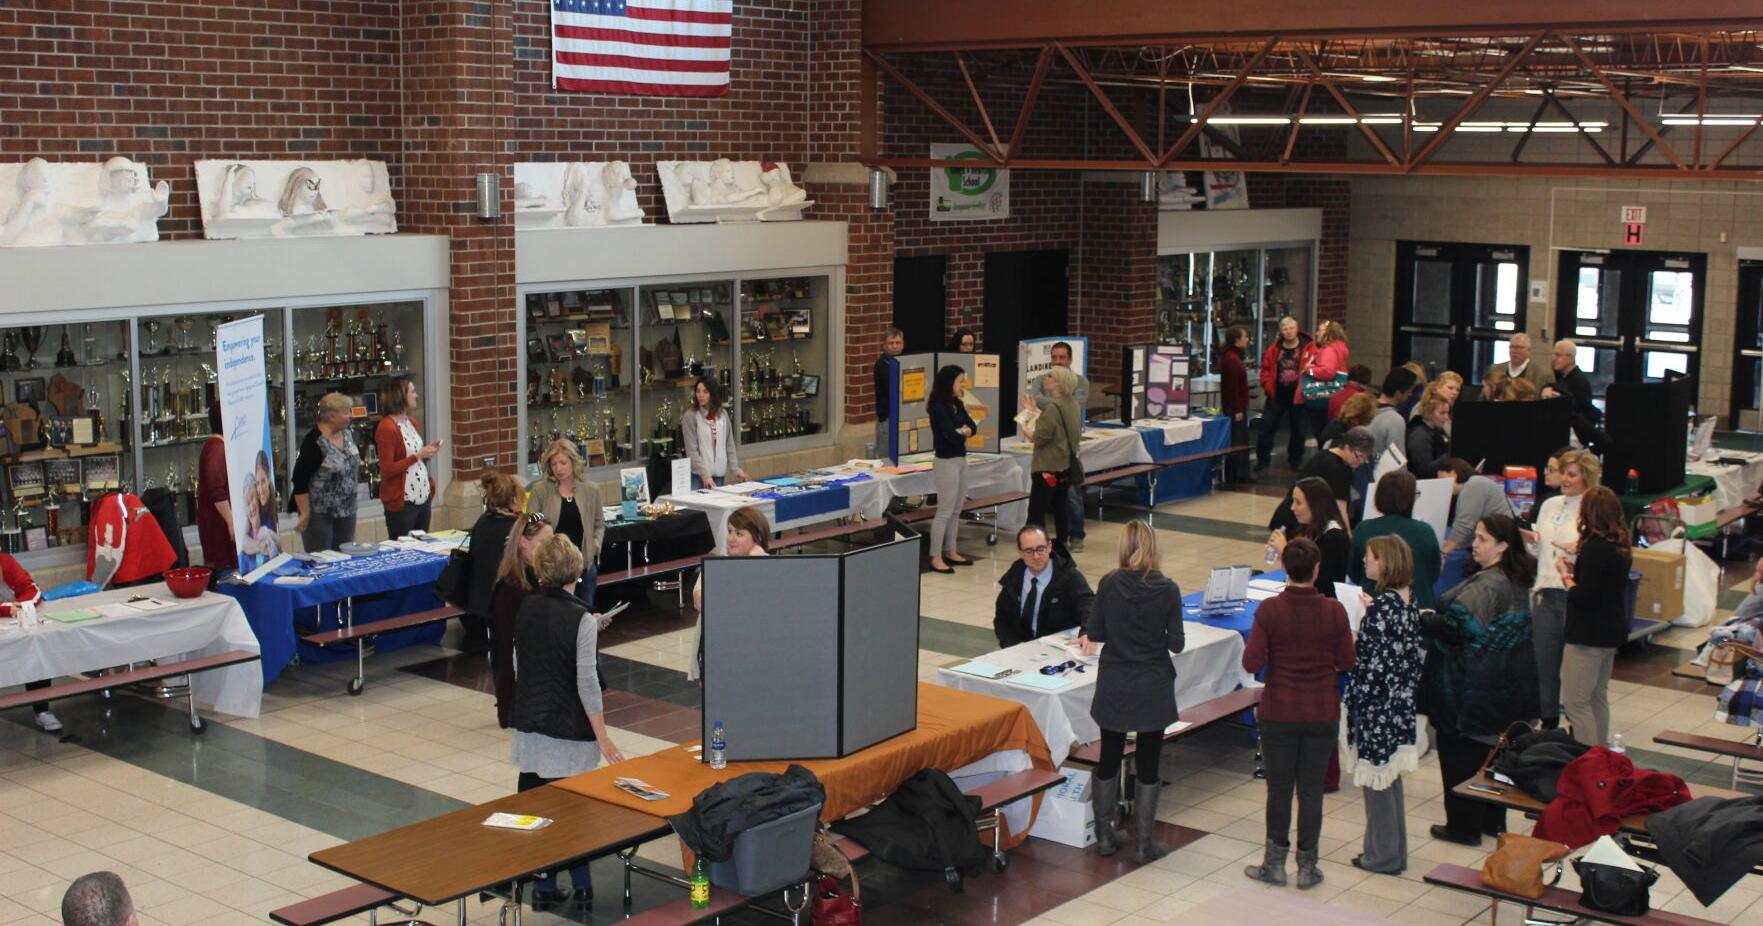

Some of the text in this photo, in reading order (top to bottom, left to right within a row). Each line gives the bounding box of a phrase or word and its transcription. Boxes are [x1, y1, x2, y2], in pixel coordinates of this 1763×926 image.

[1626, 208, 1643, 221] EXIT
[1627, 224, 1641, 243] H
[223, 338, 249, 352] Empowering
